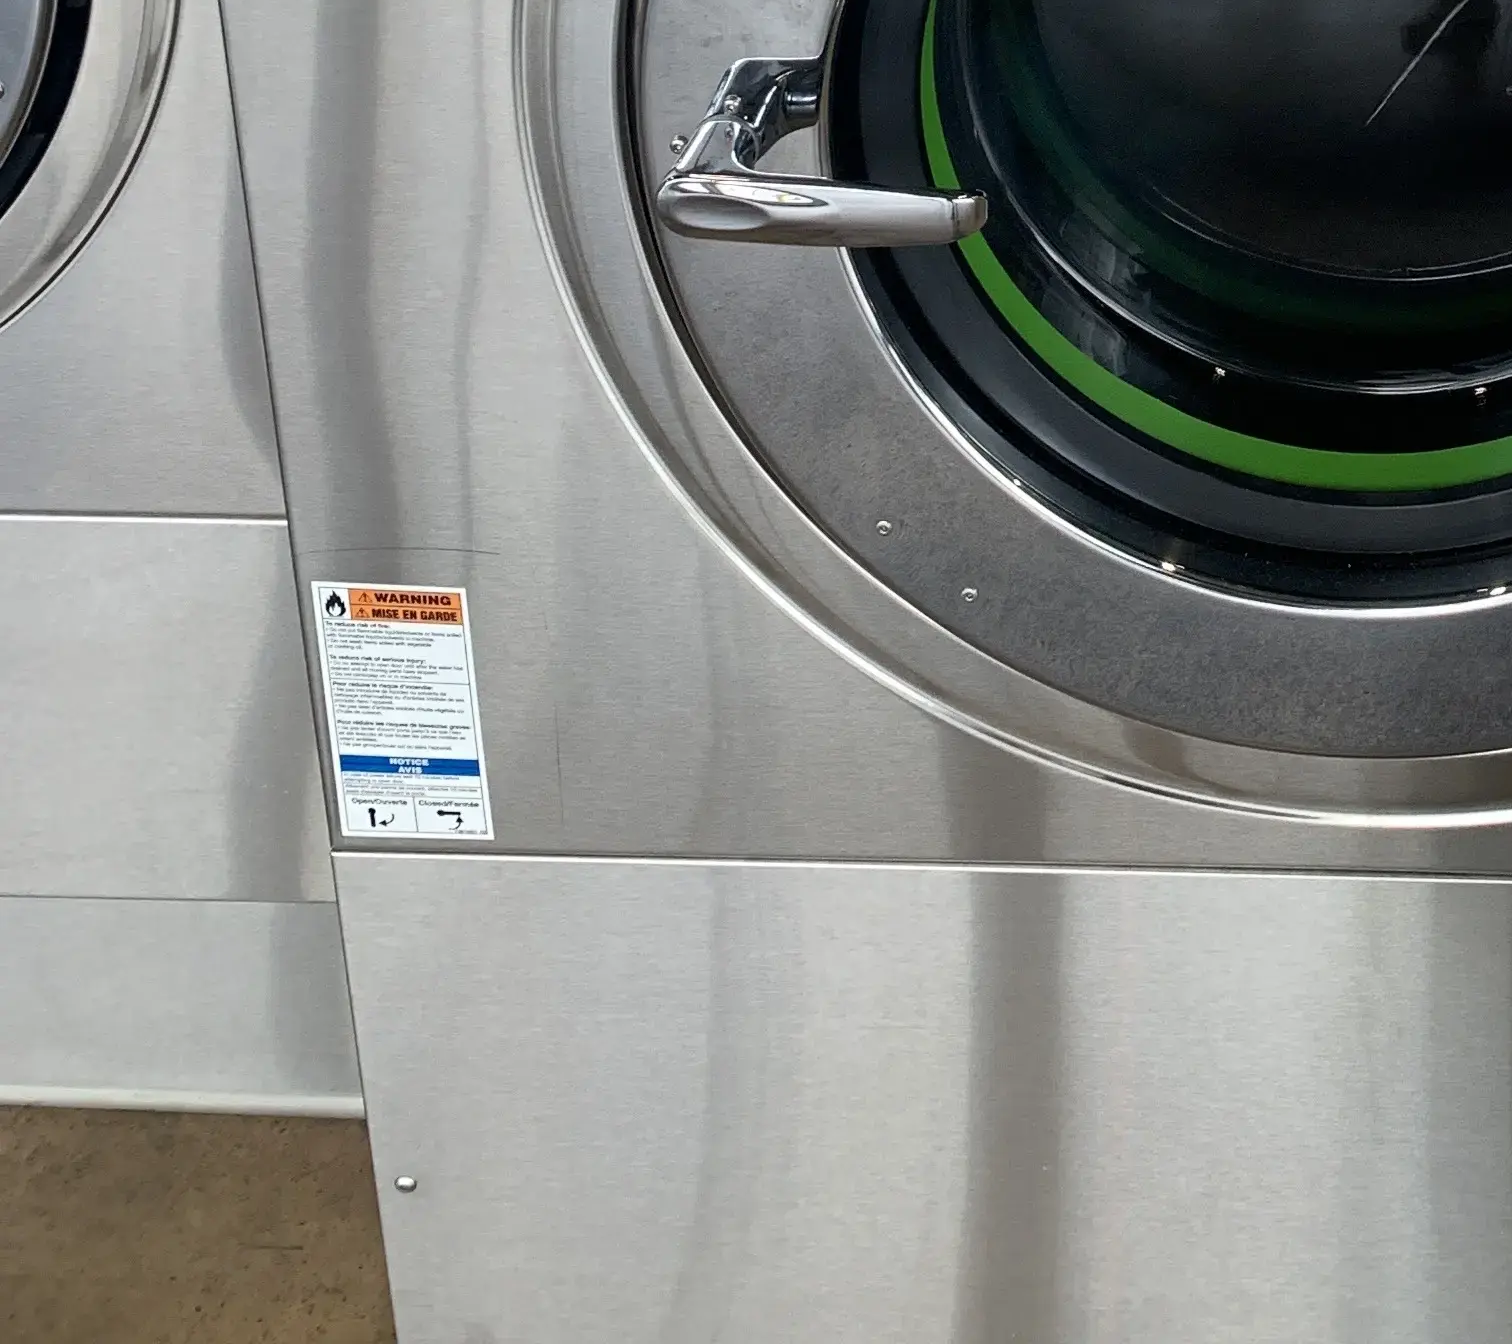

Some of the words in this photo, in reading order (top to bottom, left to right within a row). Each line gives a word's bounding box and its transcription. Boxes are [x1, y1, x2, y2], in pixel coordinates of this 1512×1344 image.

[374, 593, 451, 606] WARNING
[371, 608, 400, 619] MISE
[403, 610, 417, 620] EN
[420, 610, 458, 622] GARDE
[389, 758, 430, 767] NOTICE
[398, 766, 423, 774] AVIS
[351, 797, 408, 806] Open/Ouverte
[418, 799, 480, 808] Closed/Fermée
